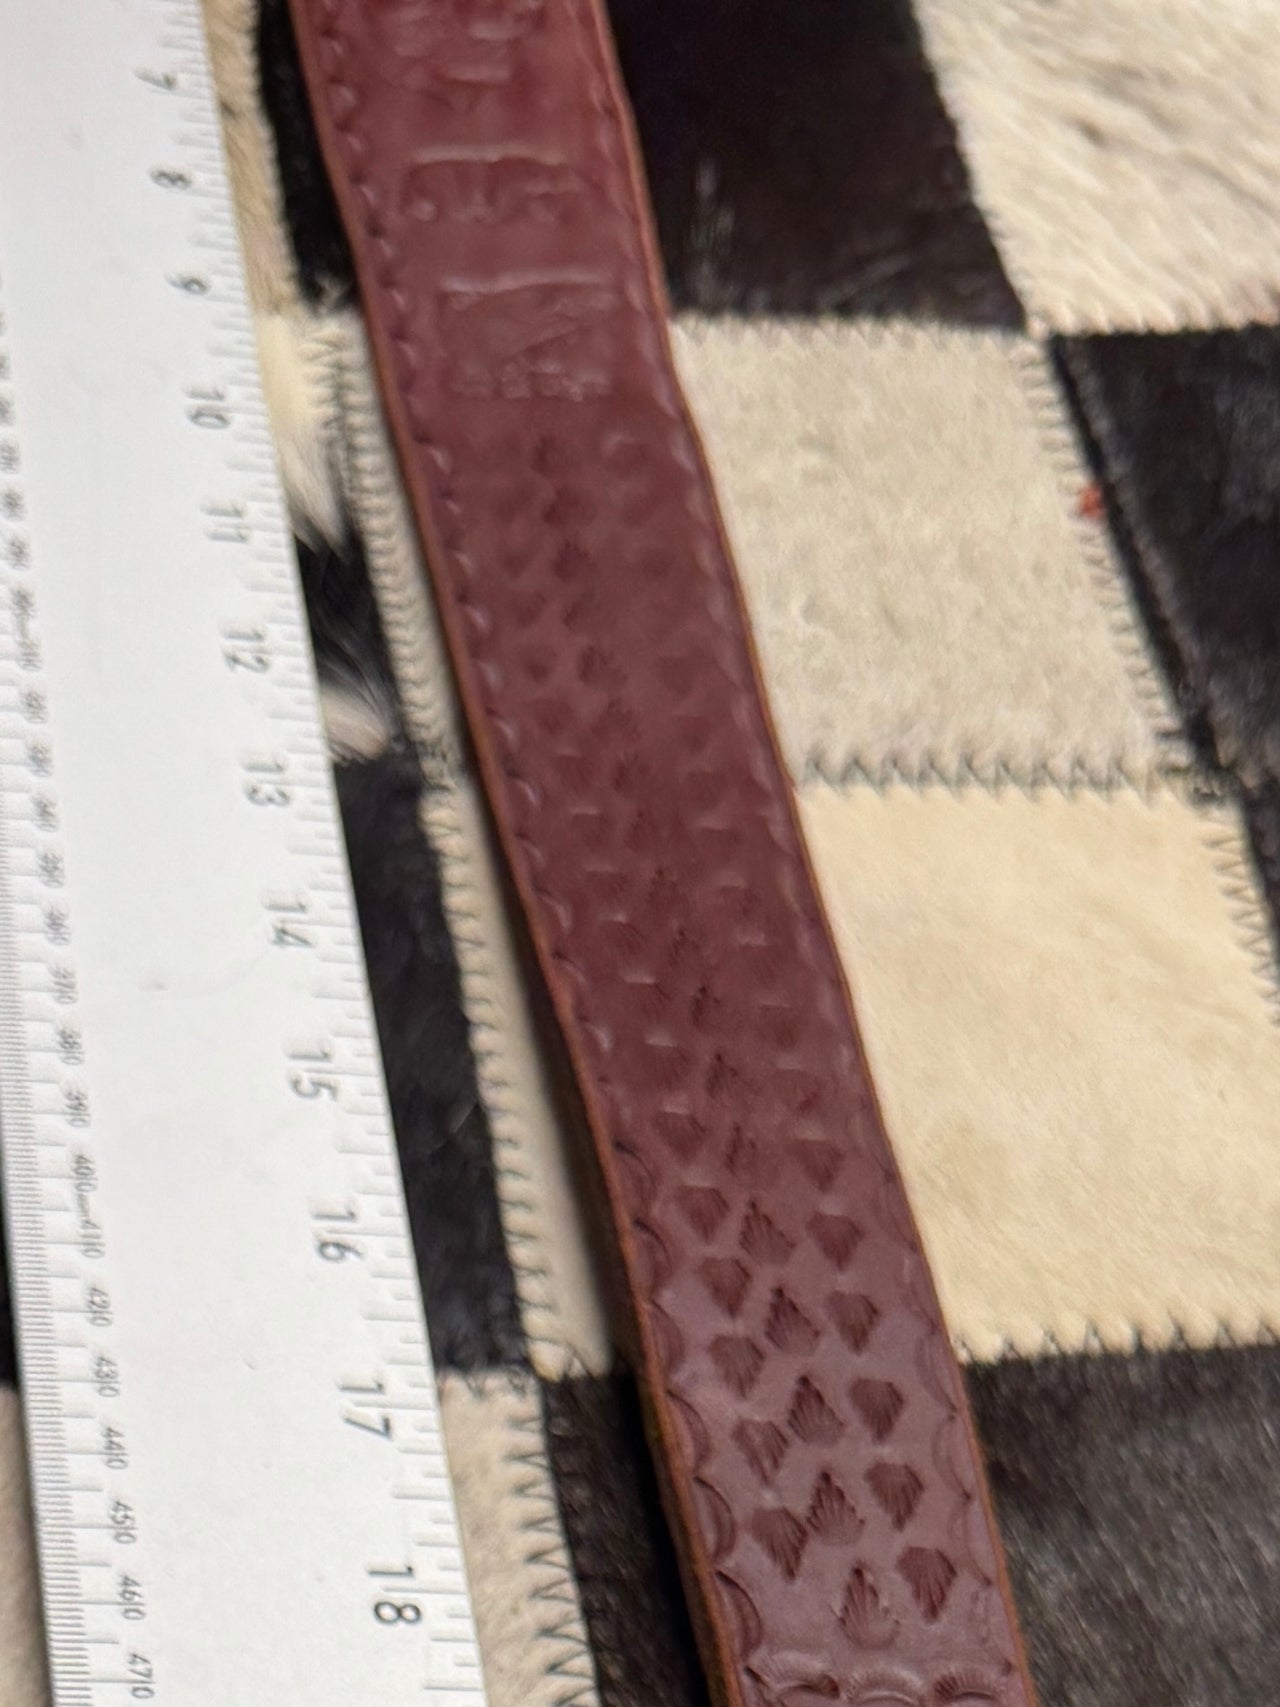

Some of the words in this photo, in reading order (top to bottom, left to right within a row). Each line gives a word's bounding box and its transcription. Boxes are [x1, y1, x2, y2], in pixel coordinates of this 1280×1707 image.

[150, 169, 193, 191] 8
[167, 275, 211, 297] 9
[188, 389, 231, 430] 10
[204, 504, 249, 543] 11
[223, 628, 270, 674] 12
[244, 758, 290, 806] 13
[265, 899, 310, 948] 14
[52, 968, 78, 1004] 370
[60, 1029, 85, 1064] 380
[289, 1047, 337, 1099] 15
[66, 1090, 91, 1128] 390
[79, 1219, 107, 1258] 410
[311, 1207, 362, 1263] 16
[87, 1287, 113, 1326] 420
[95, 1357, 120, 1397] 430
[341, 1380, 392, 1438] 17
[105, 1429, 128, 1470] 440
[114, 1501, 135, 1543] 450
[122, 1577, 144, 1619] 460
[369, 1567, 421, 1625] 18
[130, 1655, 153, 1700] 470
